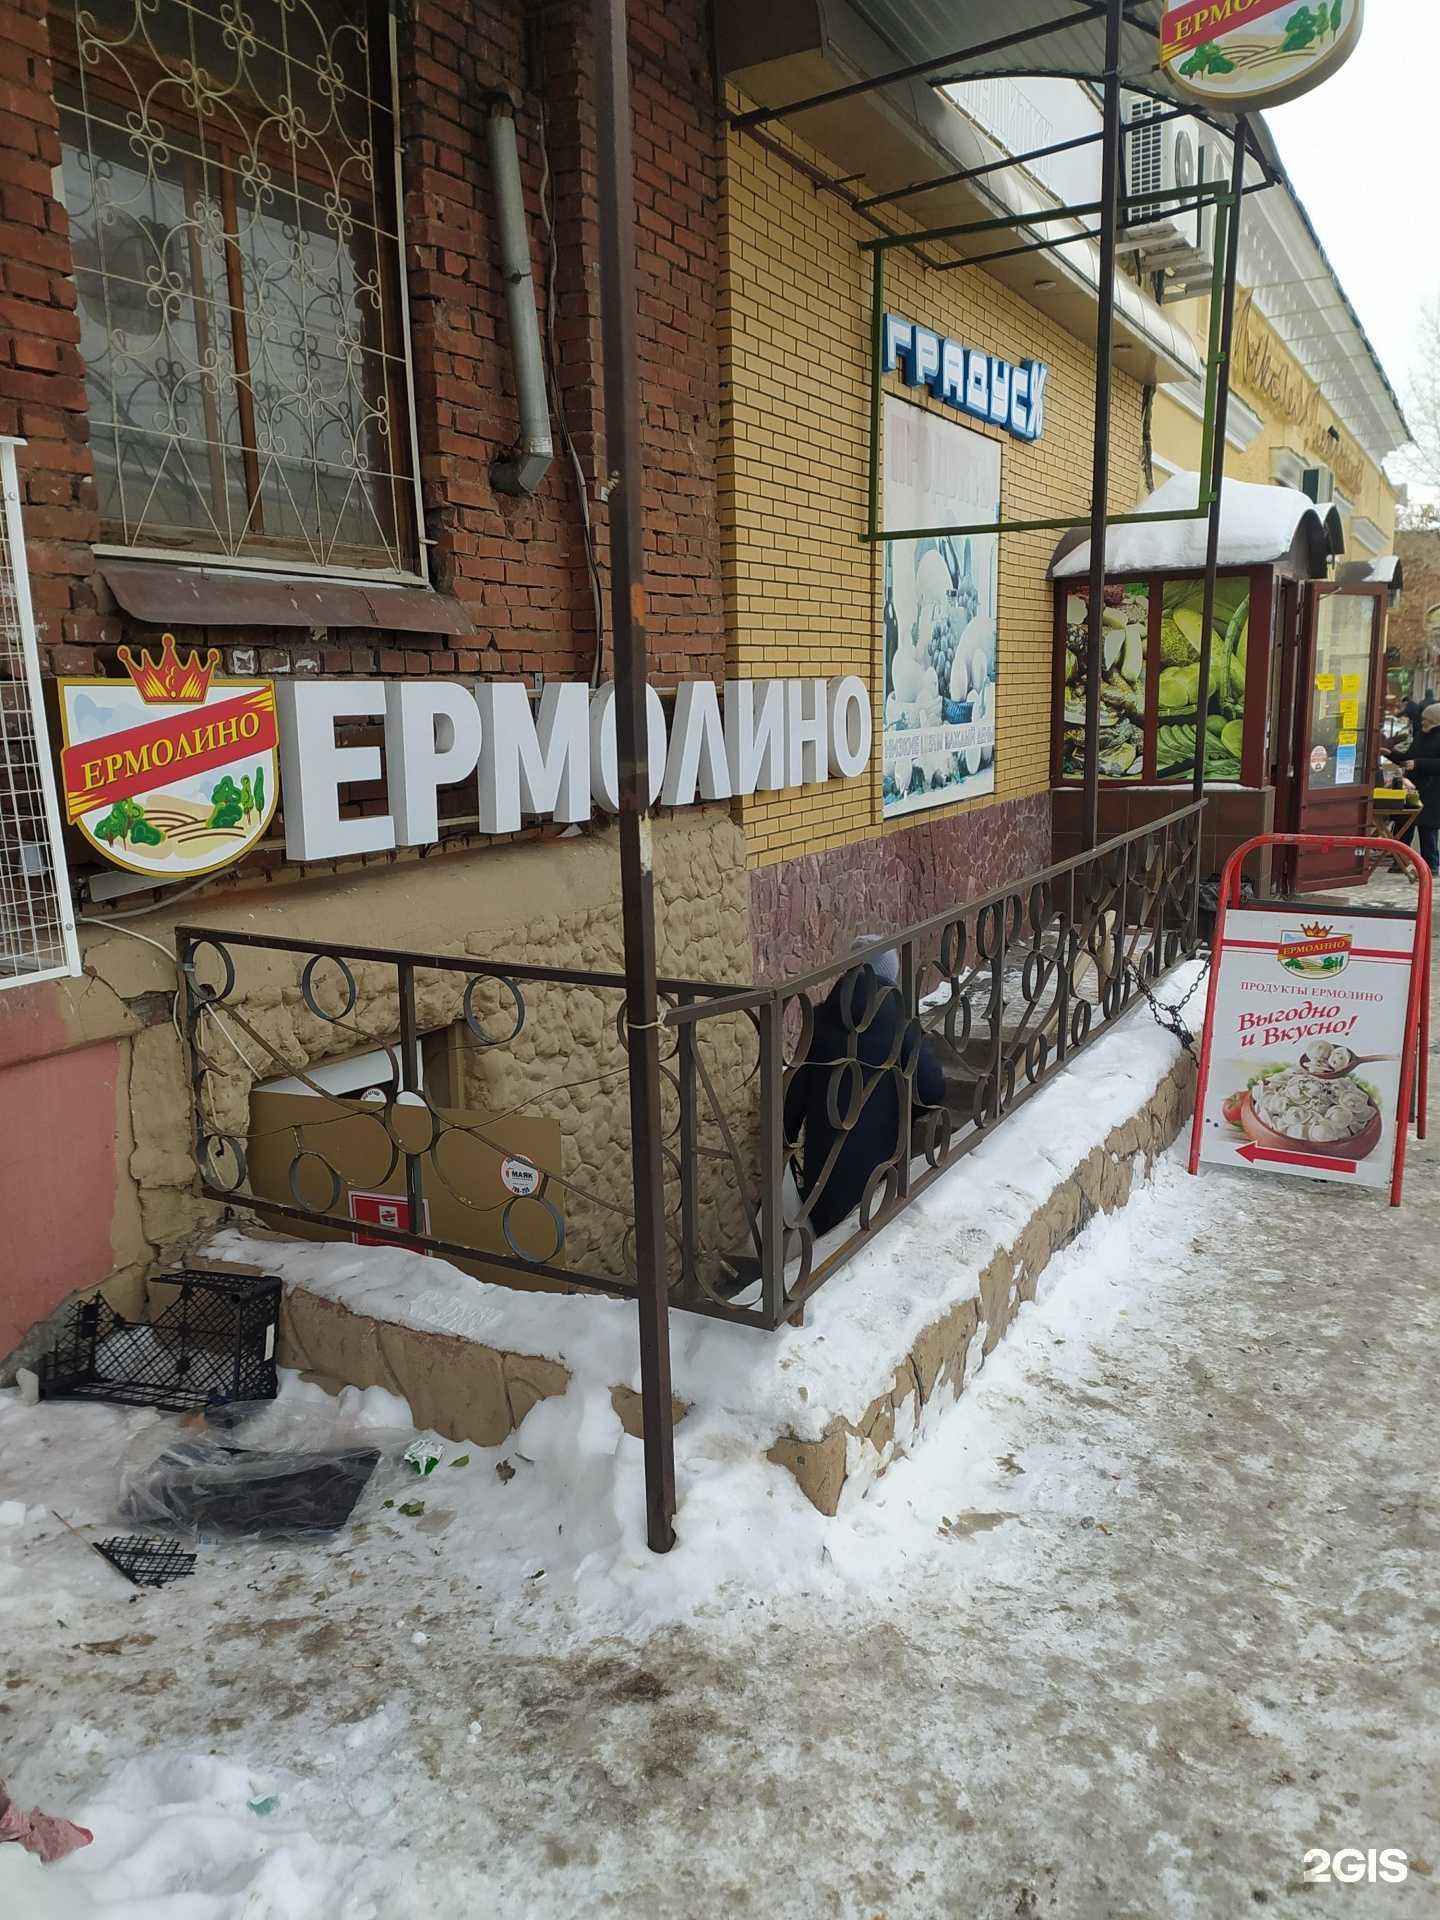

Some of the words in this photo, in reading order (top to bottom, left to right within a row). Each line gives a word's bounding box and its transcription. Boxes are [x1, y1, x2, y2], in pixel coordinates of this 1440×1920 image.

[1174, 0, 1262, 42] ЕРМО
[81, 711, 260, 791] ЕРМОЛИНО
[286, 676, 872, 861] ЕРМОЛИНО
[1283, 940, 1346, 955] ЕРМОЛИНО
[1240, 981, 1308, 996] ПРОДУКТЫ
[1311, 987, 1384, 1002] ЕРМОЛИНО
[1237, 1000, 1341, 1033] Выгодно
[1241, 1033, 1256, 1047] и
[1262, 1015, 1359, 1047] Вкусно!
